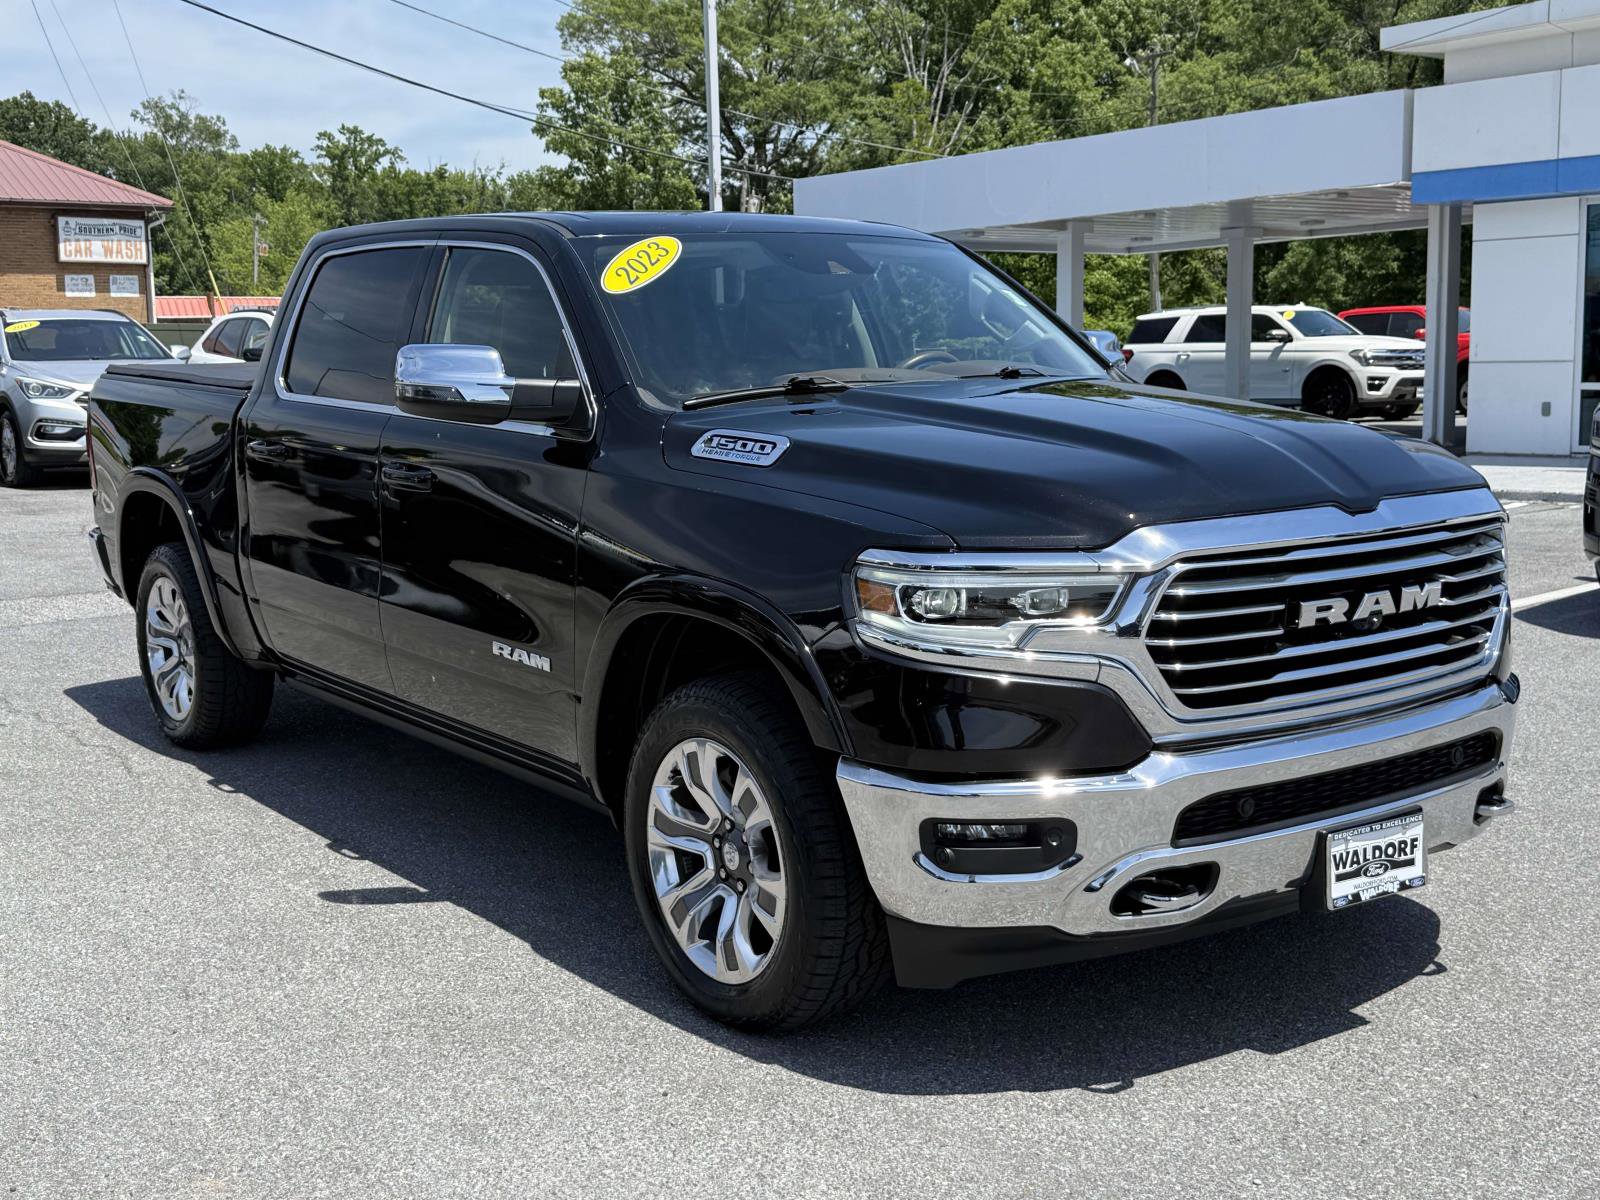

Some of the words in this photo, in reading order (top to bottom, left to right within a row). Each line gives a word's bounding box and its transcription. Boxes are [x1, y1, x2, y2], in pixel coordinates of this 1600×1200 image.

[78, 225, 115, 234] SOUTHERN
[119, 226, 137, 235] PRIDE
[63, 239, 93, 258] CAR
[102, 239, 144, 260] WASH
[615, 241, 669, 285] 2023
[701, 448, 724, 456] HEMI
[703, 436, 775, 454] 1500
[1298, 581, 1441, 628] RAM
[492, 640, 551, 672] RAM
[1334, 827, 1370, 840] DEDICATED
[1382, 815, 1423, 829] EXCELLENCE
[1332, 837, 1419, 871] WALDORF
[1366, 864, 1385, 876] Ford
[1359, 881, 1400, 901] WALDORF
